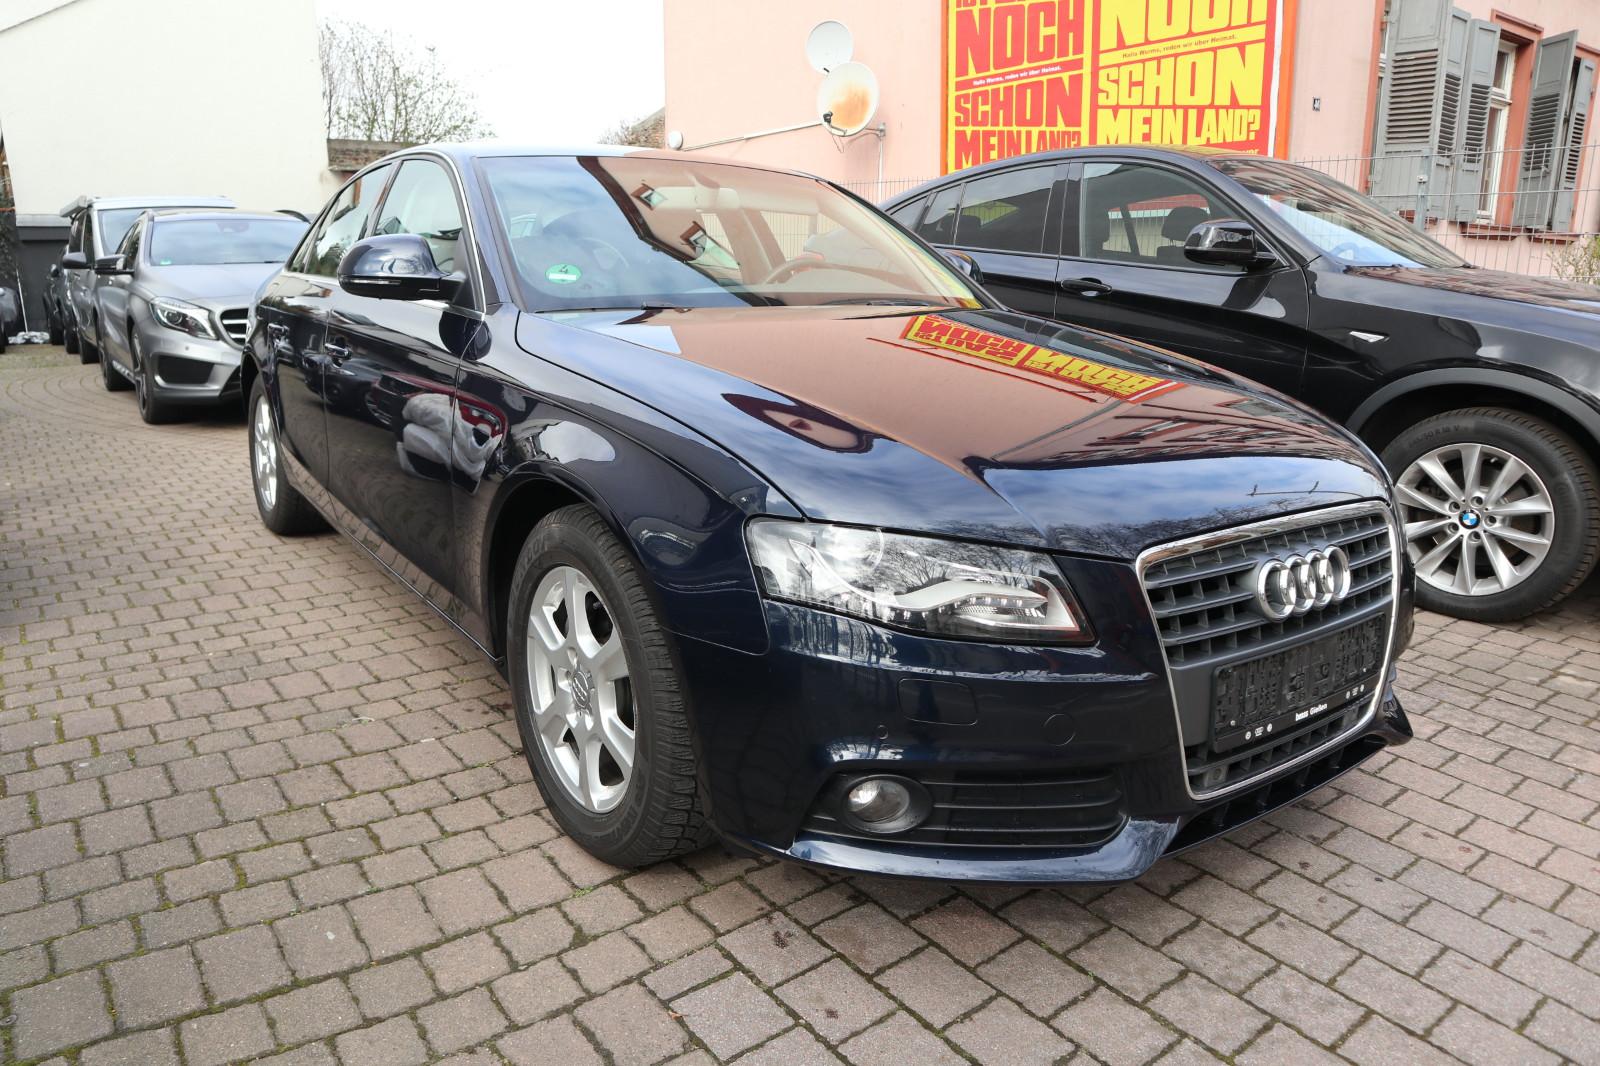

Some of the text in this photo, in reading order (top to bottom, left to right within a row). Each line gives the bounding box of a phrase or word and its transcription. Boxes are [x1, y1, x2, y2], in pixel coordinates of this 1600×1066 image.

[956, 0, 1084, 76] NOCH
[955, 74, 1082, 127] SCHON
[1098, 42, 1264, 106] SCHON
[955, 130, 1021, 169] MEIN
[1097, 109, 1261, 146] MEIN LAND?
